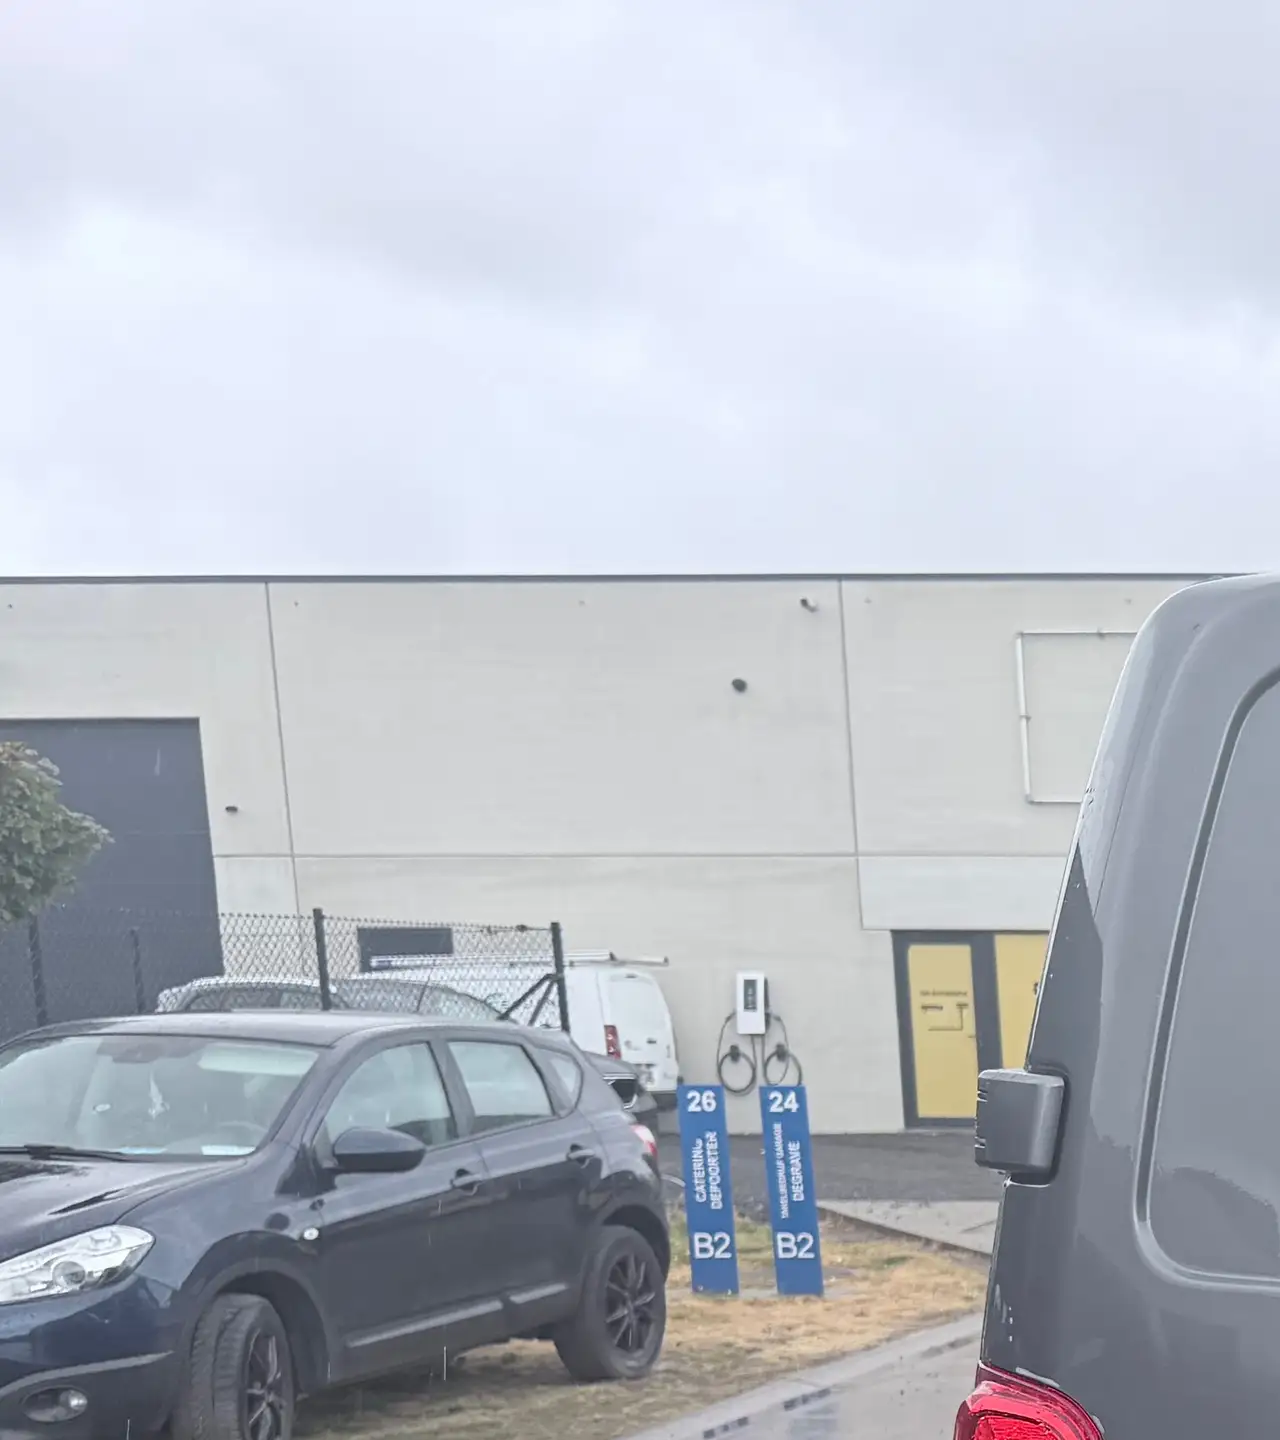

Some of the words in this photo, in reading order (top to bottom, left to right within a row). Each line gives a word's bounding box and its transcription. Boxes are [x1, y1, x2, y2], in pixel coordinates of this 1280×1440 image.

[686, 1090, 717, 1113] 26
[768, 1091, 799, 1113] 24
[692, 1138, 707, 1203] CATERING
[705, 1131, 723, 1210] DEPOORTER
[788, 1140, 805, 1202] DEGRAVE
[694, 1232, 732, 1259] B2
[776, 1232, 815, 1259] B2
